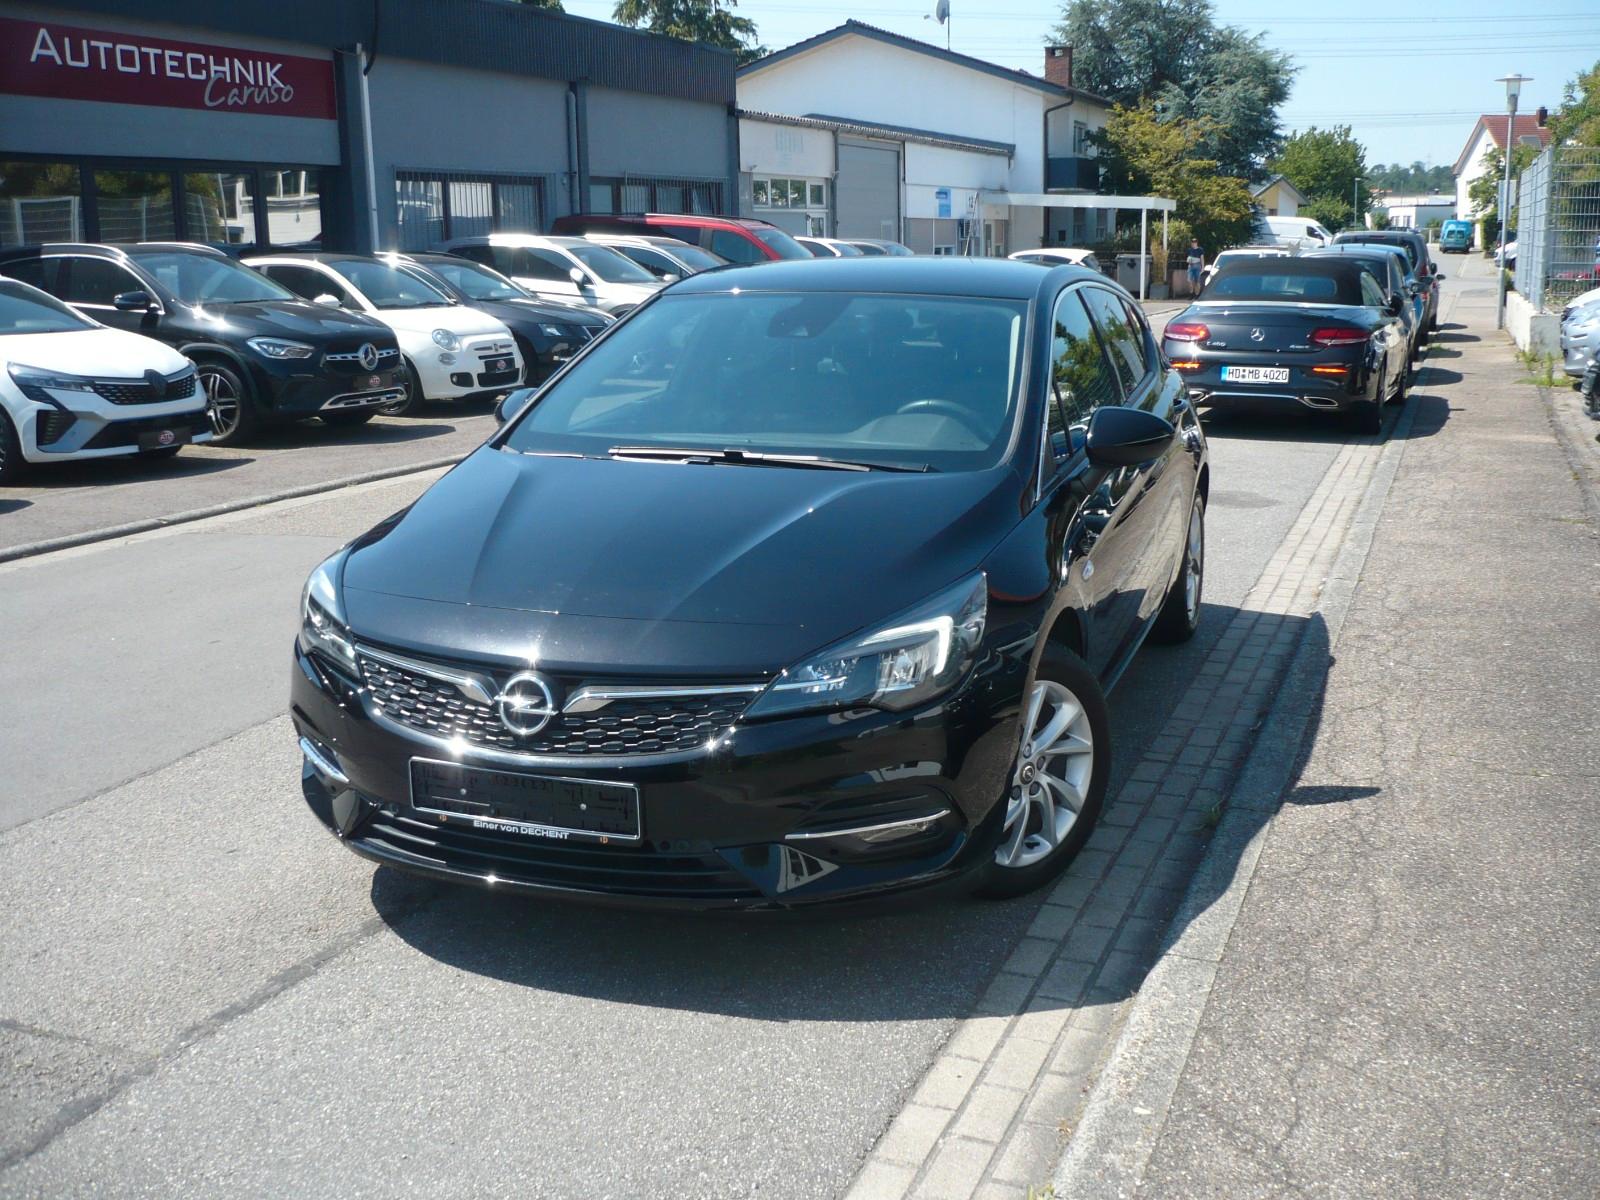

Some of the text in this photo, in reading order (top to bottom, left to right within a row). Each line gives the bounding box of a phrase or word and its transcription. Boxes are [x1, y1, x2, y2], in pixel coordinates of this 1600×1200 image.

[30, 28, 285, 87] AUTOTECHNIK
[204, 73, 294, 107] Caruso
[1263, 370, 1288, 381] 4020
[473, 820, 570, 839] Einer von DECHENT
